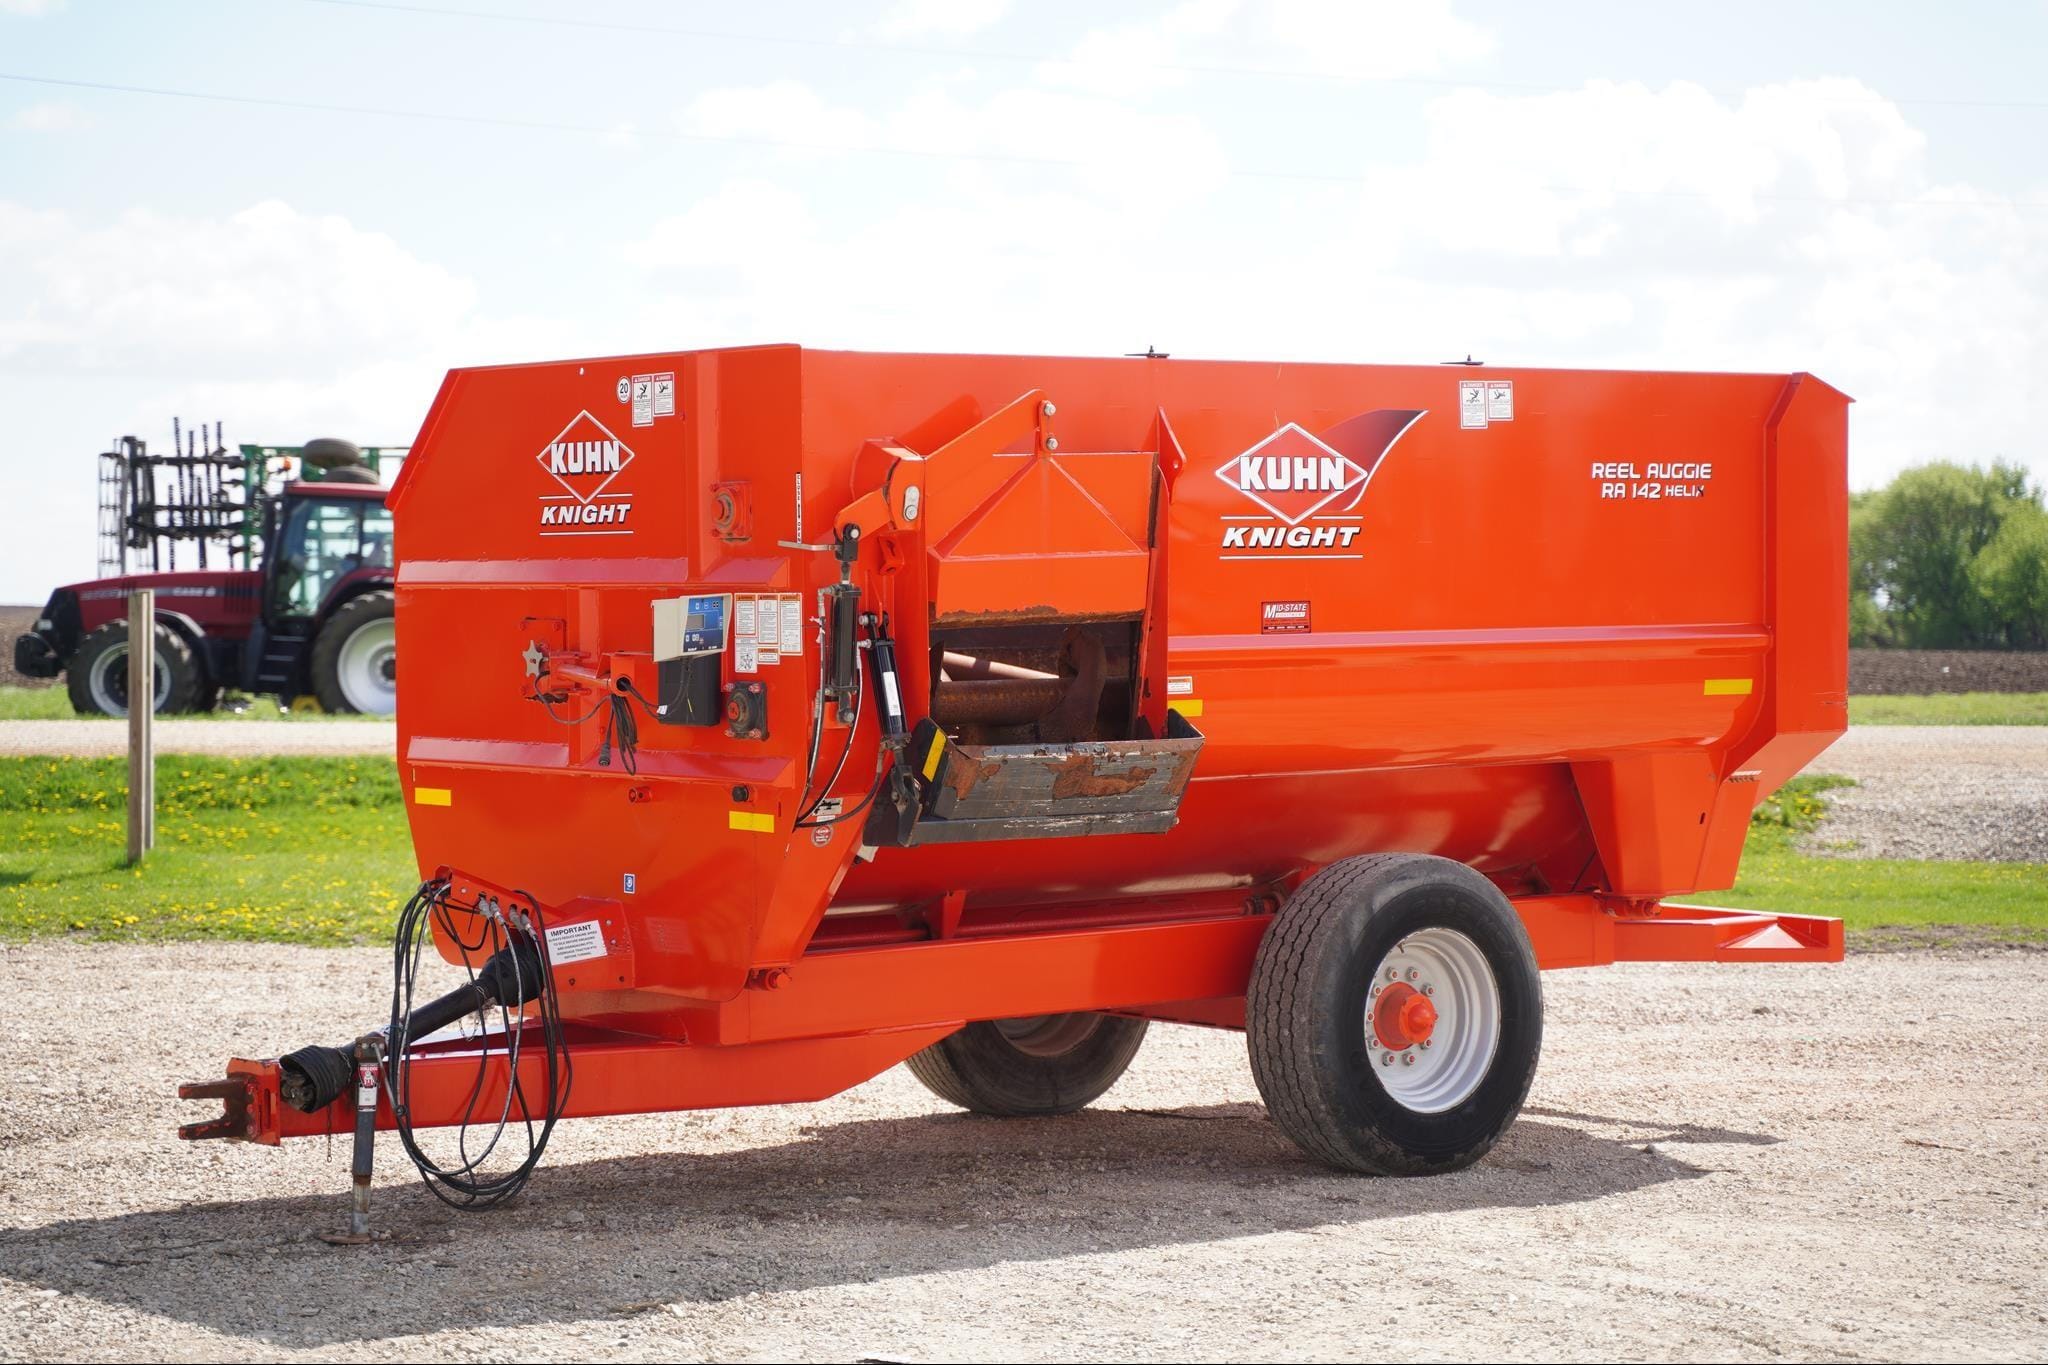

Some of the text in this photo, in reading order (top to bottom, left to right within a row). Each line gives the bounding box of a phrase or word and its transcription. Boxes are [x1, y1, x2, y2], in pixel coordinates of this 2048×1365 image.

[620, 383, 628, 394] 20
[550, 440, 620, 476] KUHN
[1239, 456, 1346, 492] KUHN
[1592, 462, 1712, 479] REEL AUGGIE
[1602, 482, 1704, 499] RA 142 HELIX
[541, 504, 631, 525] KNIGHT
[1222, 526, 1362, 549] KNIGHT
[1264, 604, 1308, 618] MID-STATE
[550, 924, 592, 937] IMPORTANT
